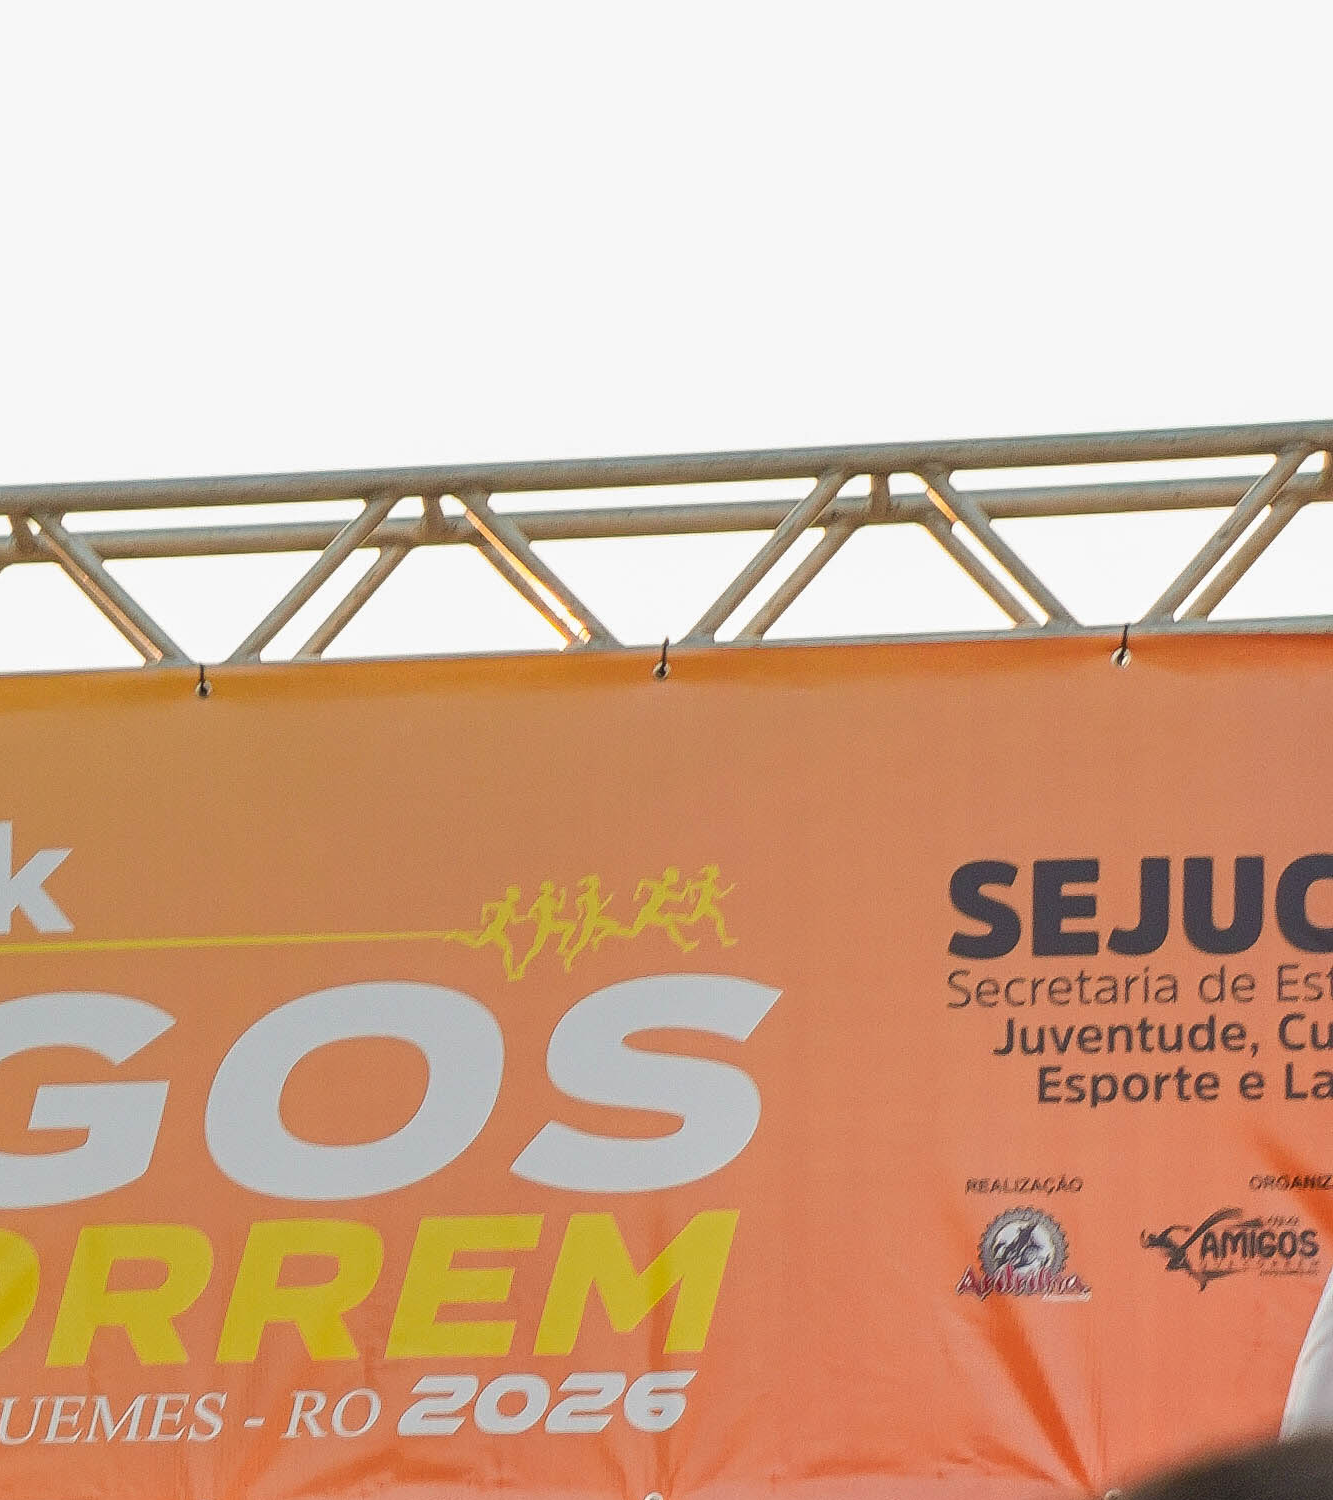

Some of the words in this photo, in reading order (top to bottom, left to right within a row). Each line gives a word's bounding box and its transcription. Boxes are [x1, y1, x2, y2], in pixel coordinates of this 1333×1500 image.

[947, 966, 1179, 1009] Secretaria
[1198, 966, 1256, 1003] de
[992, 1014, 1260, 1057] Juventude,
[1037, 1064, 1220, 1108] Esporte
[1239, 1070, 1265, 1100] e
[1200, 1229, 1320, 1260] AMIGOS
[282, 1387, 382, 1438] RO
[397, 1368, 698, 1437] 2026
